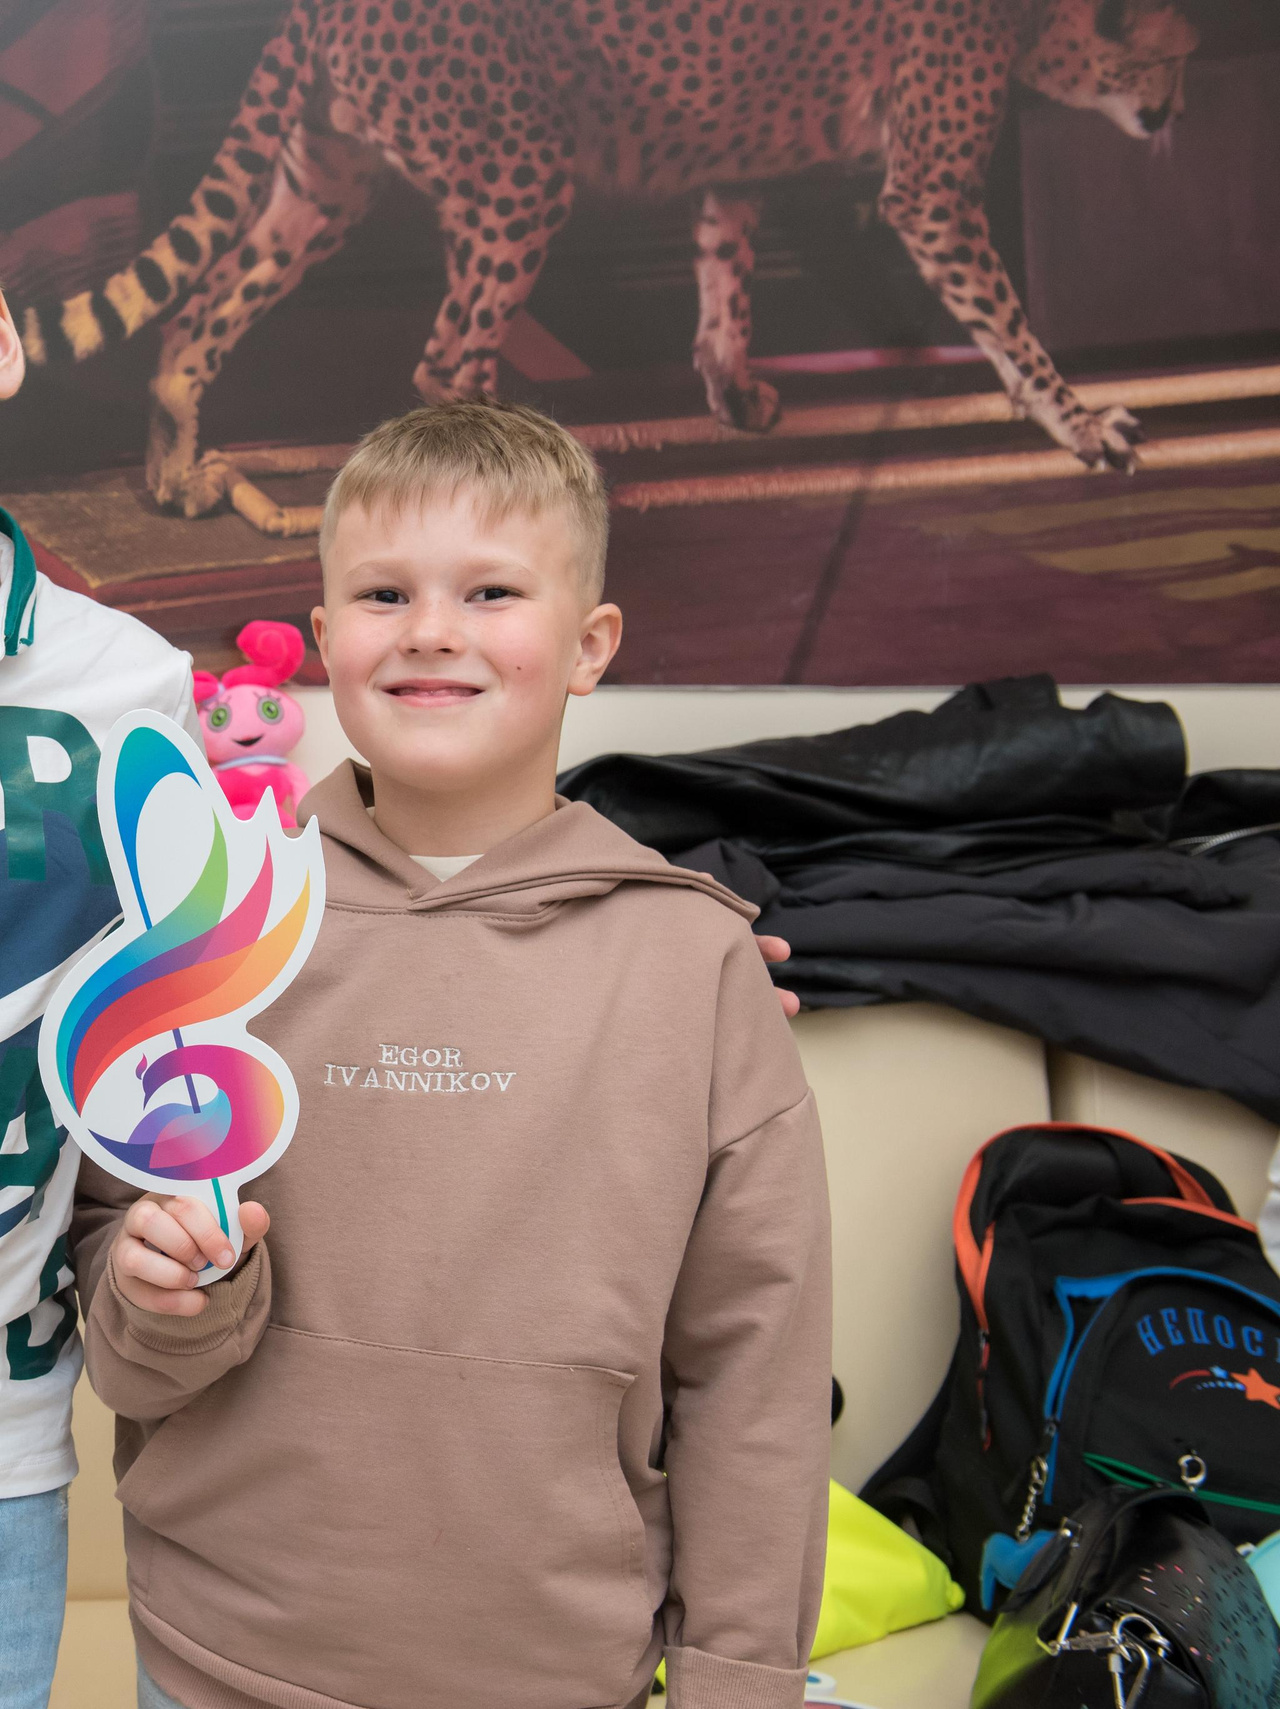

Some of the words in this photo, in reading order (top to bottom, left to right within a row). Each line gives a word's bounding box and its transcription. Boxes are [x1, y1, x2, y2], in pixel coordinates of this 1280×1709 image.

[378, 1043, 463, 1068] EGOR
[324, 1063, 517, 1093] IVANNIKOV
[1136, 1307, 1280, 1363] НЕПОС
